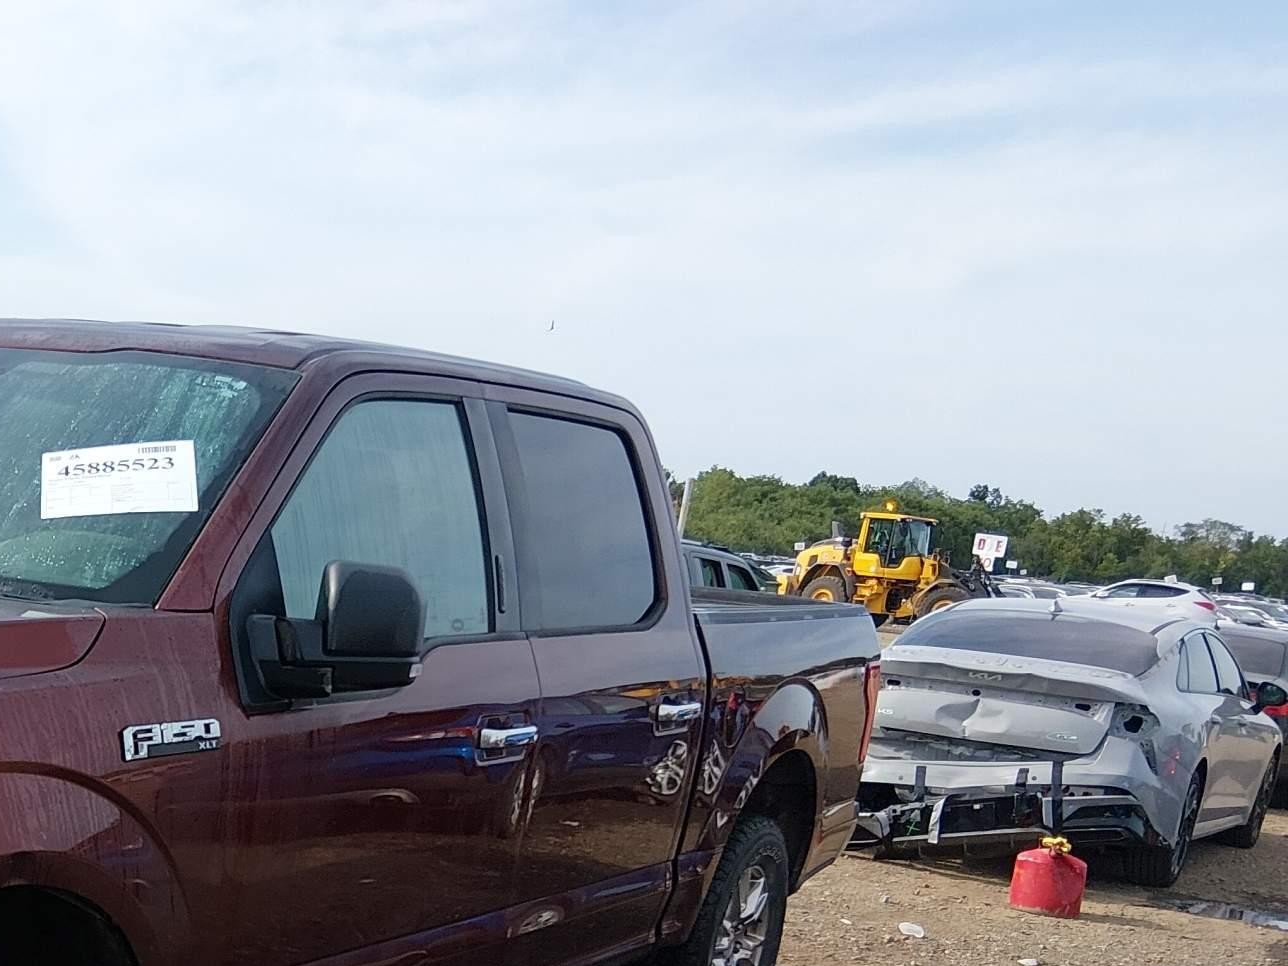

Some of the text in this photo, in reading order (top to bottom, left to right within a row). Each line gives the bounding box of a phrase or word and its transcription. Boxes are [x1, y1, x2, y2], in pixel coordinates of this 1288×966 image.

[57, 457, 175, 477] 45885523
[968, 671, 1002, 681] KIA
[198, 740, 218, 751] XLT
